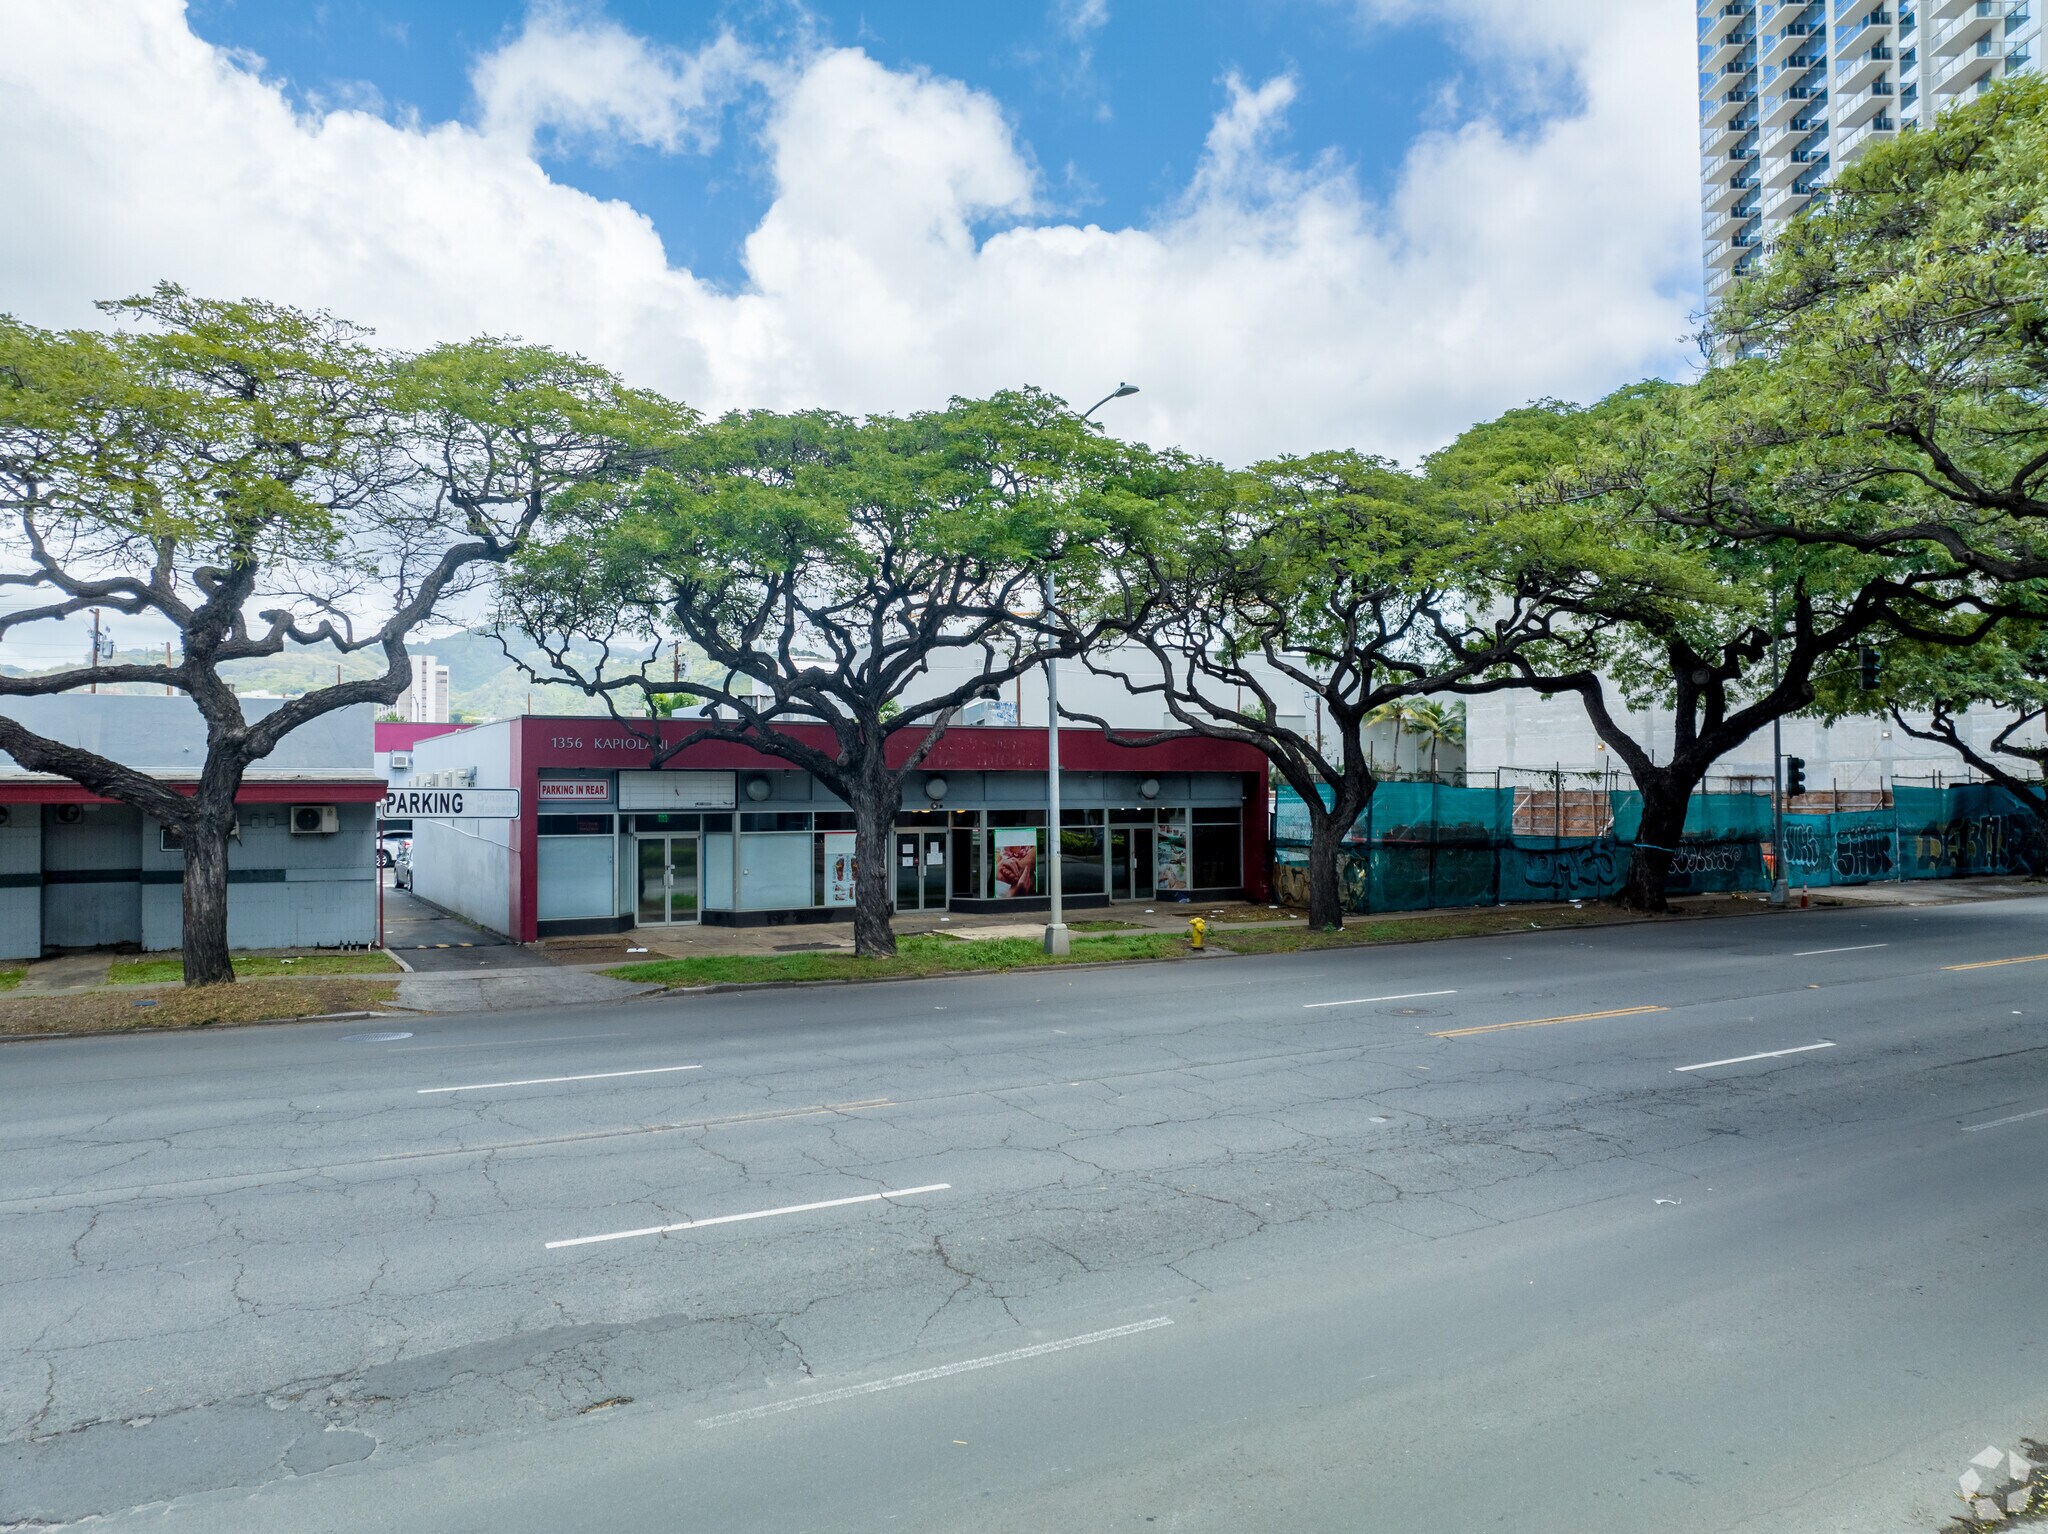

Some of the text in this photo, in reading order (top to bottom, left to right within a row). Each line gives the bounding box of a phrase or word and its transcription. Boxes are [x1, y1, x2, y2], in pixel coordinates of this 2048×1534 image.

[551, 736, 583, 749] 1356
[542, 785, 605, 795] PARKING IN REAR
[386, 792, 464, 814] PARKING
